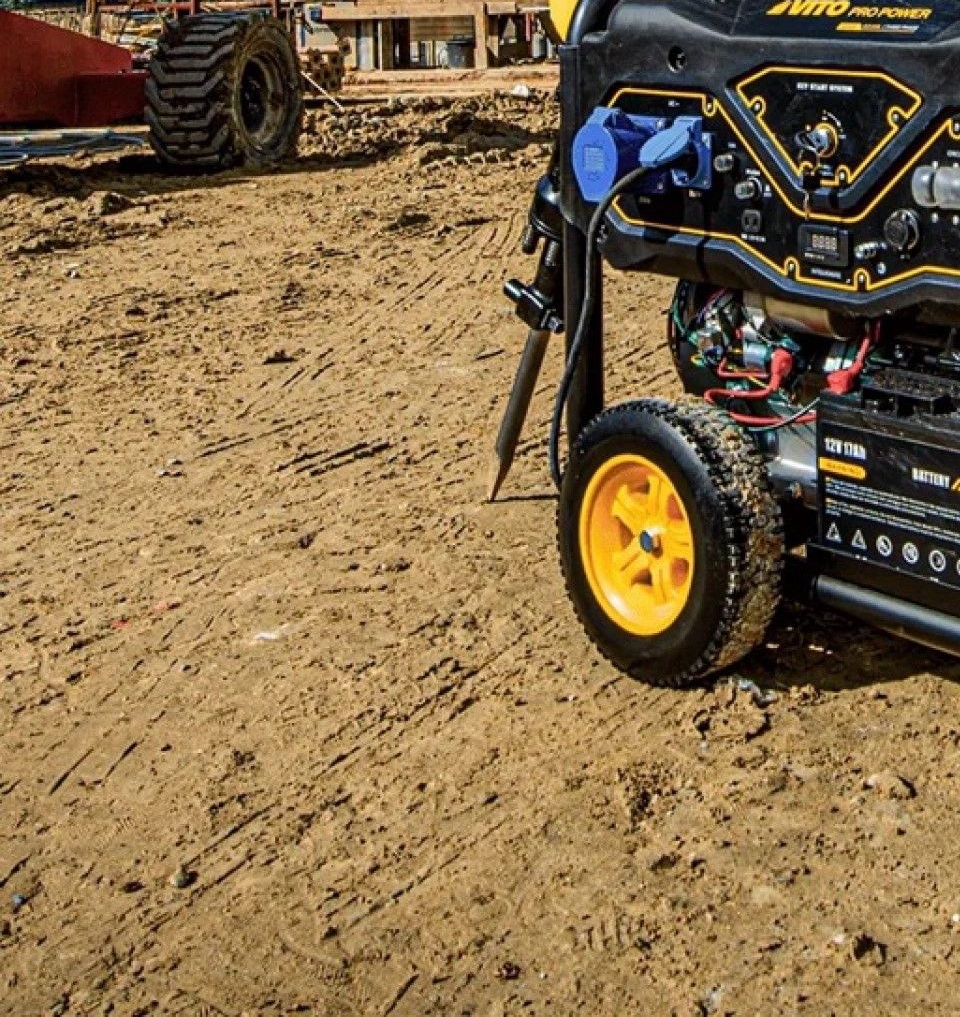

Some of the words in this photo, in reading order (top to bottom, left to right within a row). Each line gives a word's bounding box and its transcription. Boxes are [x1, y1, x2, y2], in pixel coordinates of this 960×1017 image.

[788, 0, 850, 16] VITO
[878, 7, 932, 19] POWER
[911, 467, 950, 488] BATTERY
